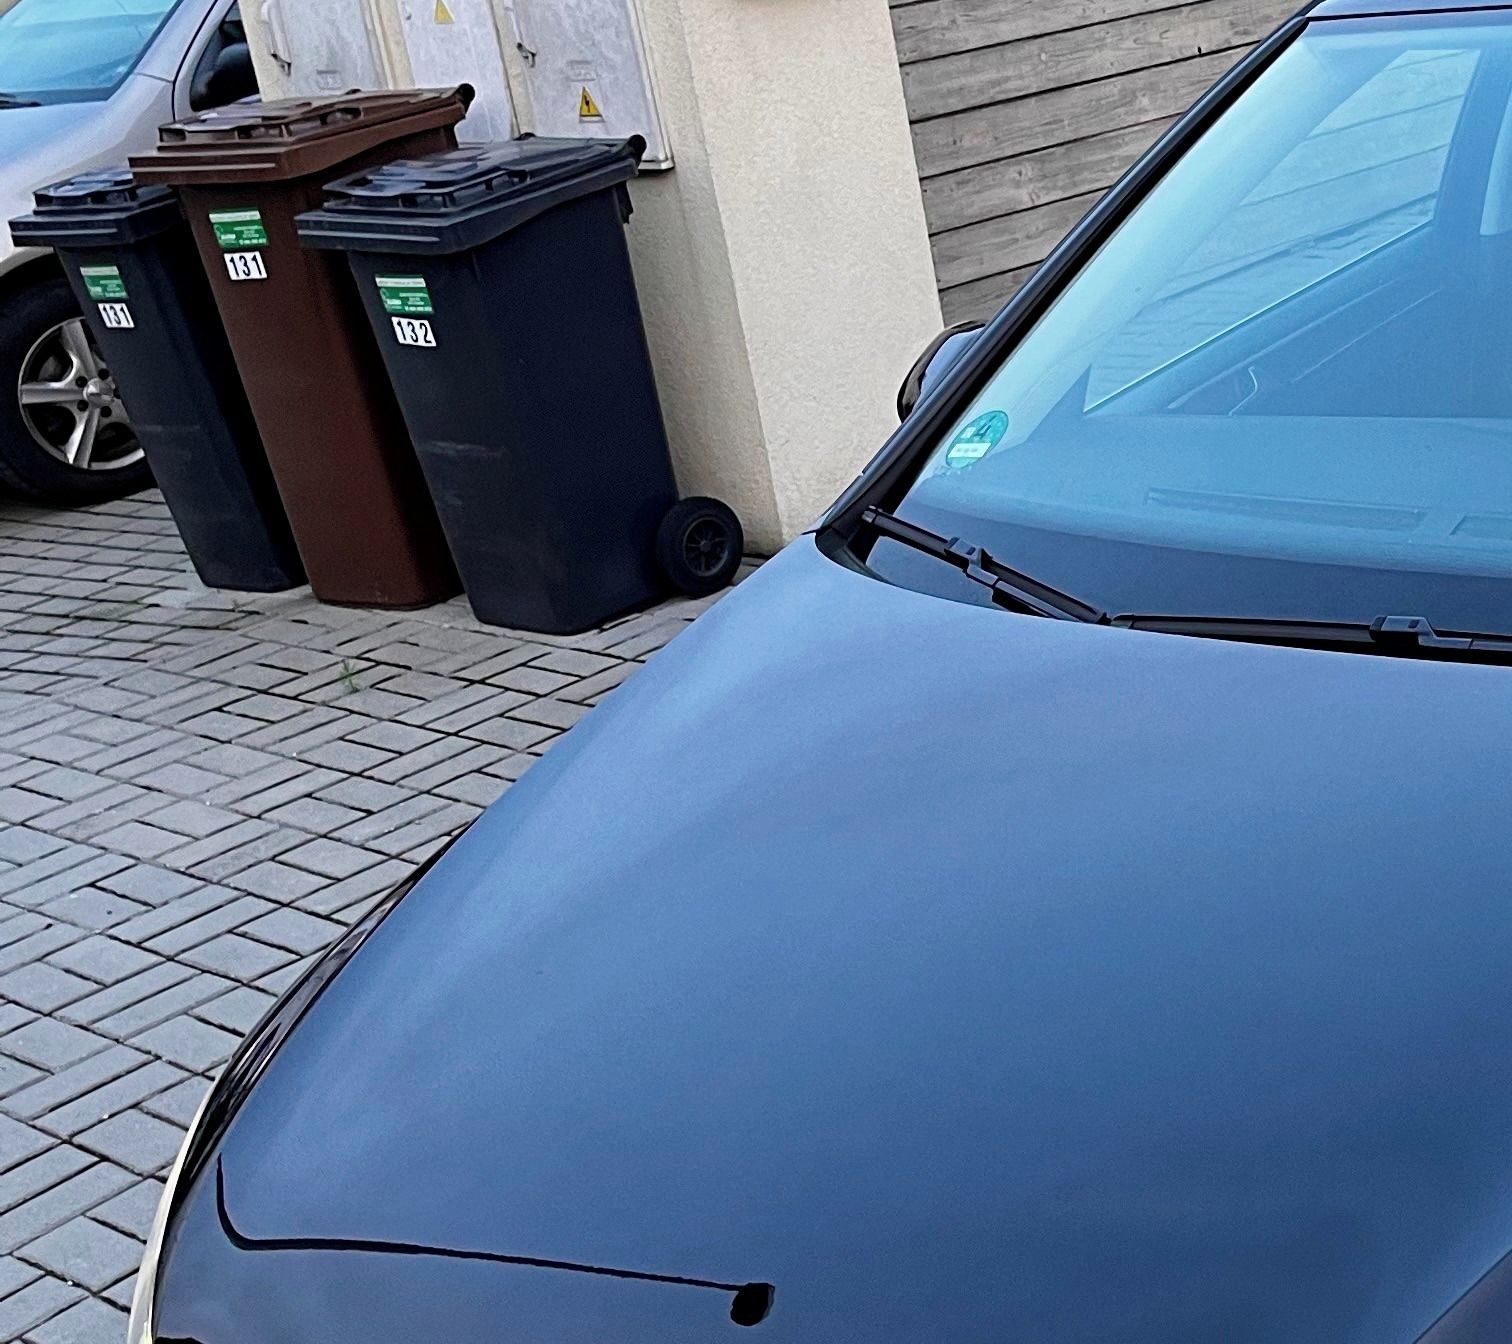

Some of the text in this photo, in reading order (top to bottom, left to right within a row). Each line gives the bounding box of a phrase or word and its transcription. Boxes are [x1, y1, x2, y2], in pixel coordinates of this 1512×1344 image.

[229, 254, 262, 277] 131
[102, 305, 131, 326] 131
[396, 319, 433, 344] 132
